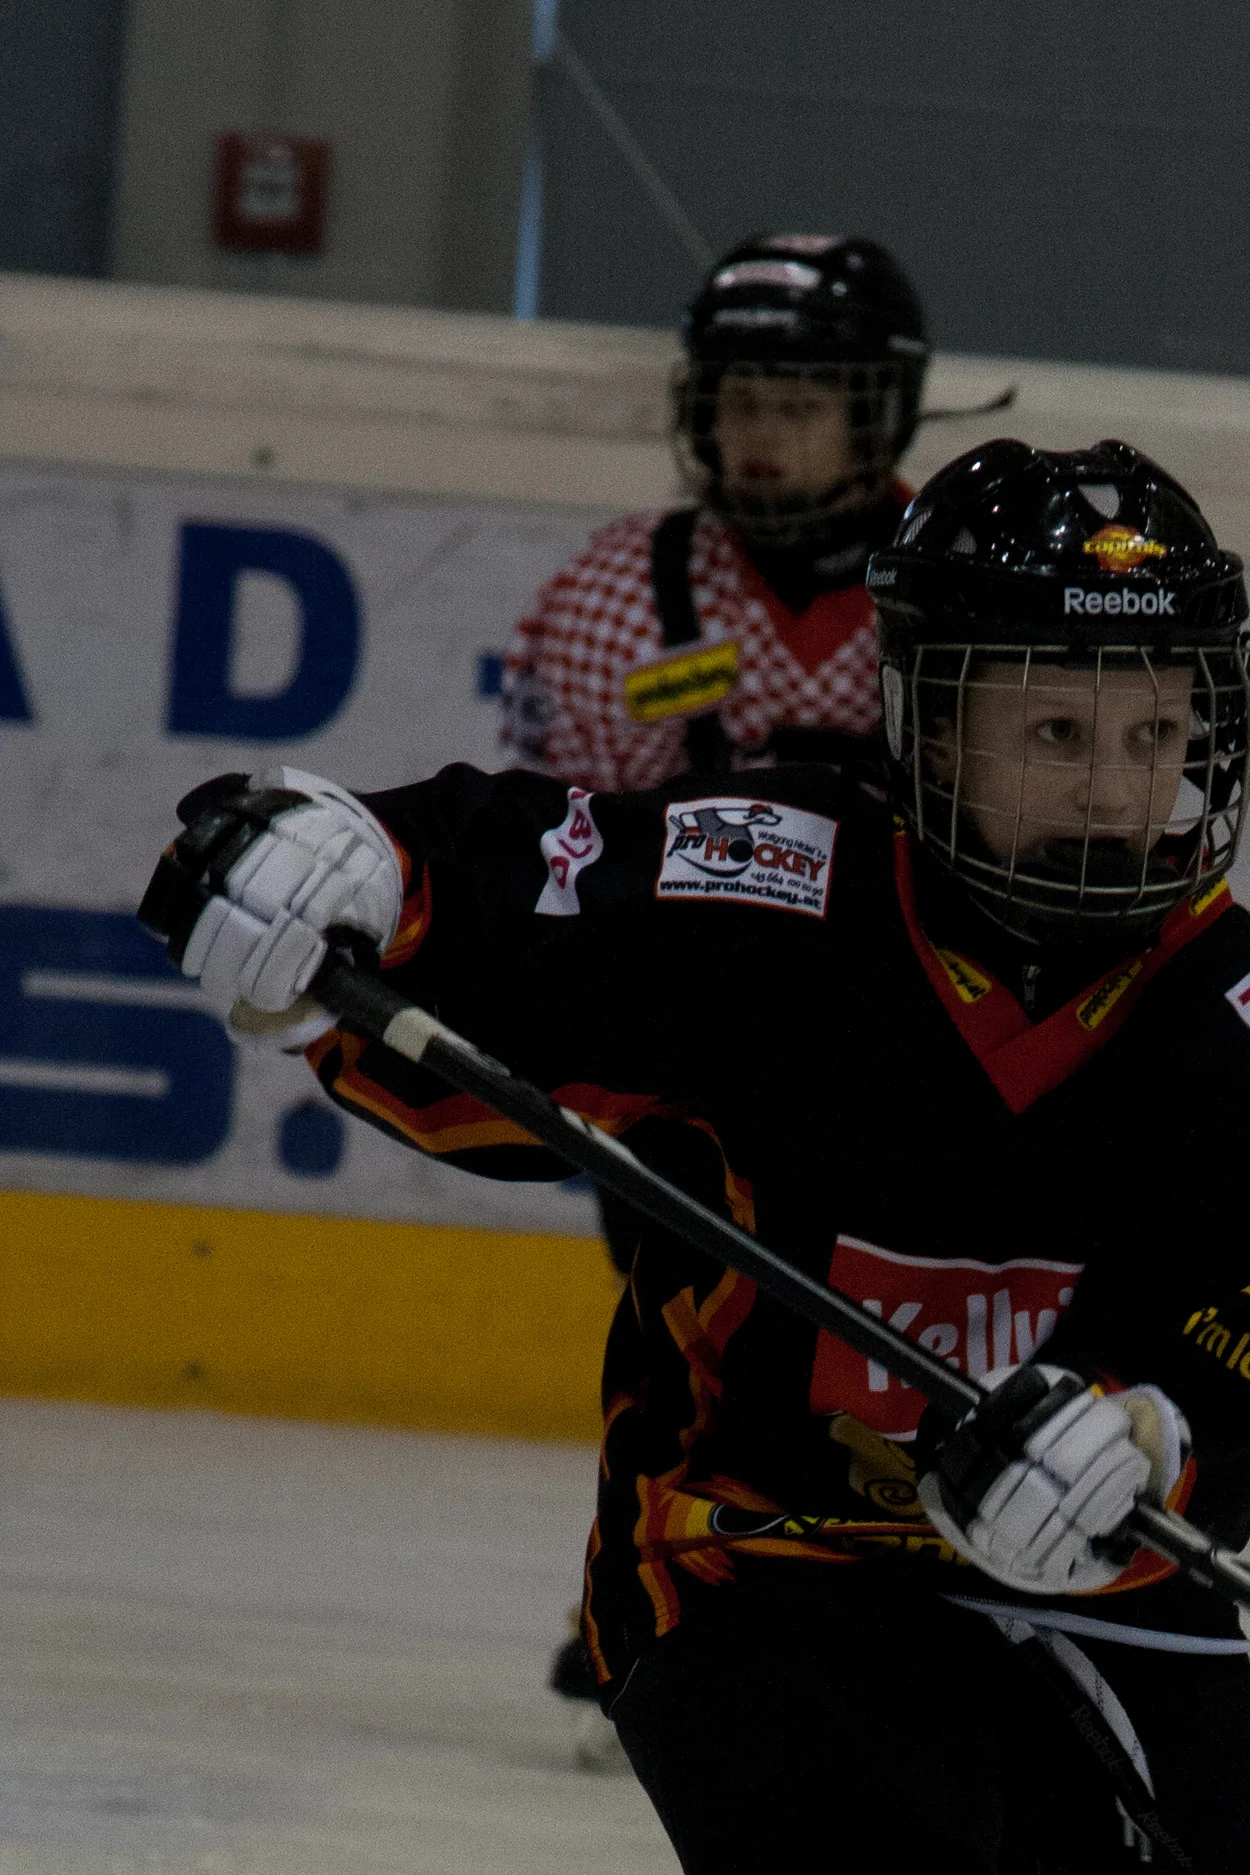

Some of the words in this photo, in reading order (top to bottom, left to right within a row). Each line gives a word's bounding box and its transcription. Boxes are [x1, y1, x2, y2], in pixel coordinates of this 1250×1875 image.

[1063, 585, 1177, 616] Reebok
[659, 879, 822, 910] www.prohockey.at
[1070, 1704, 1124, 1775] Reebok
